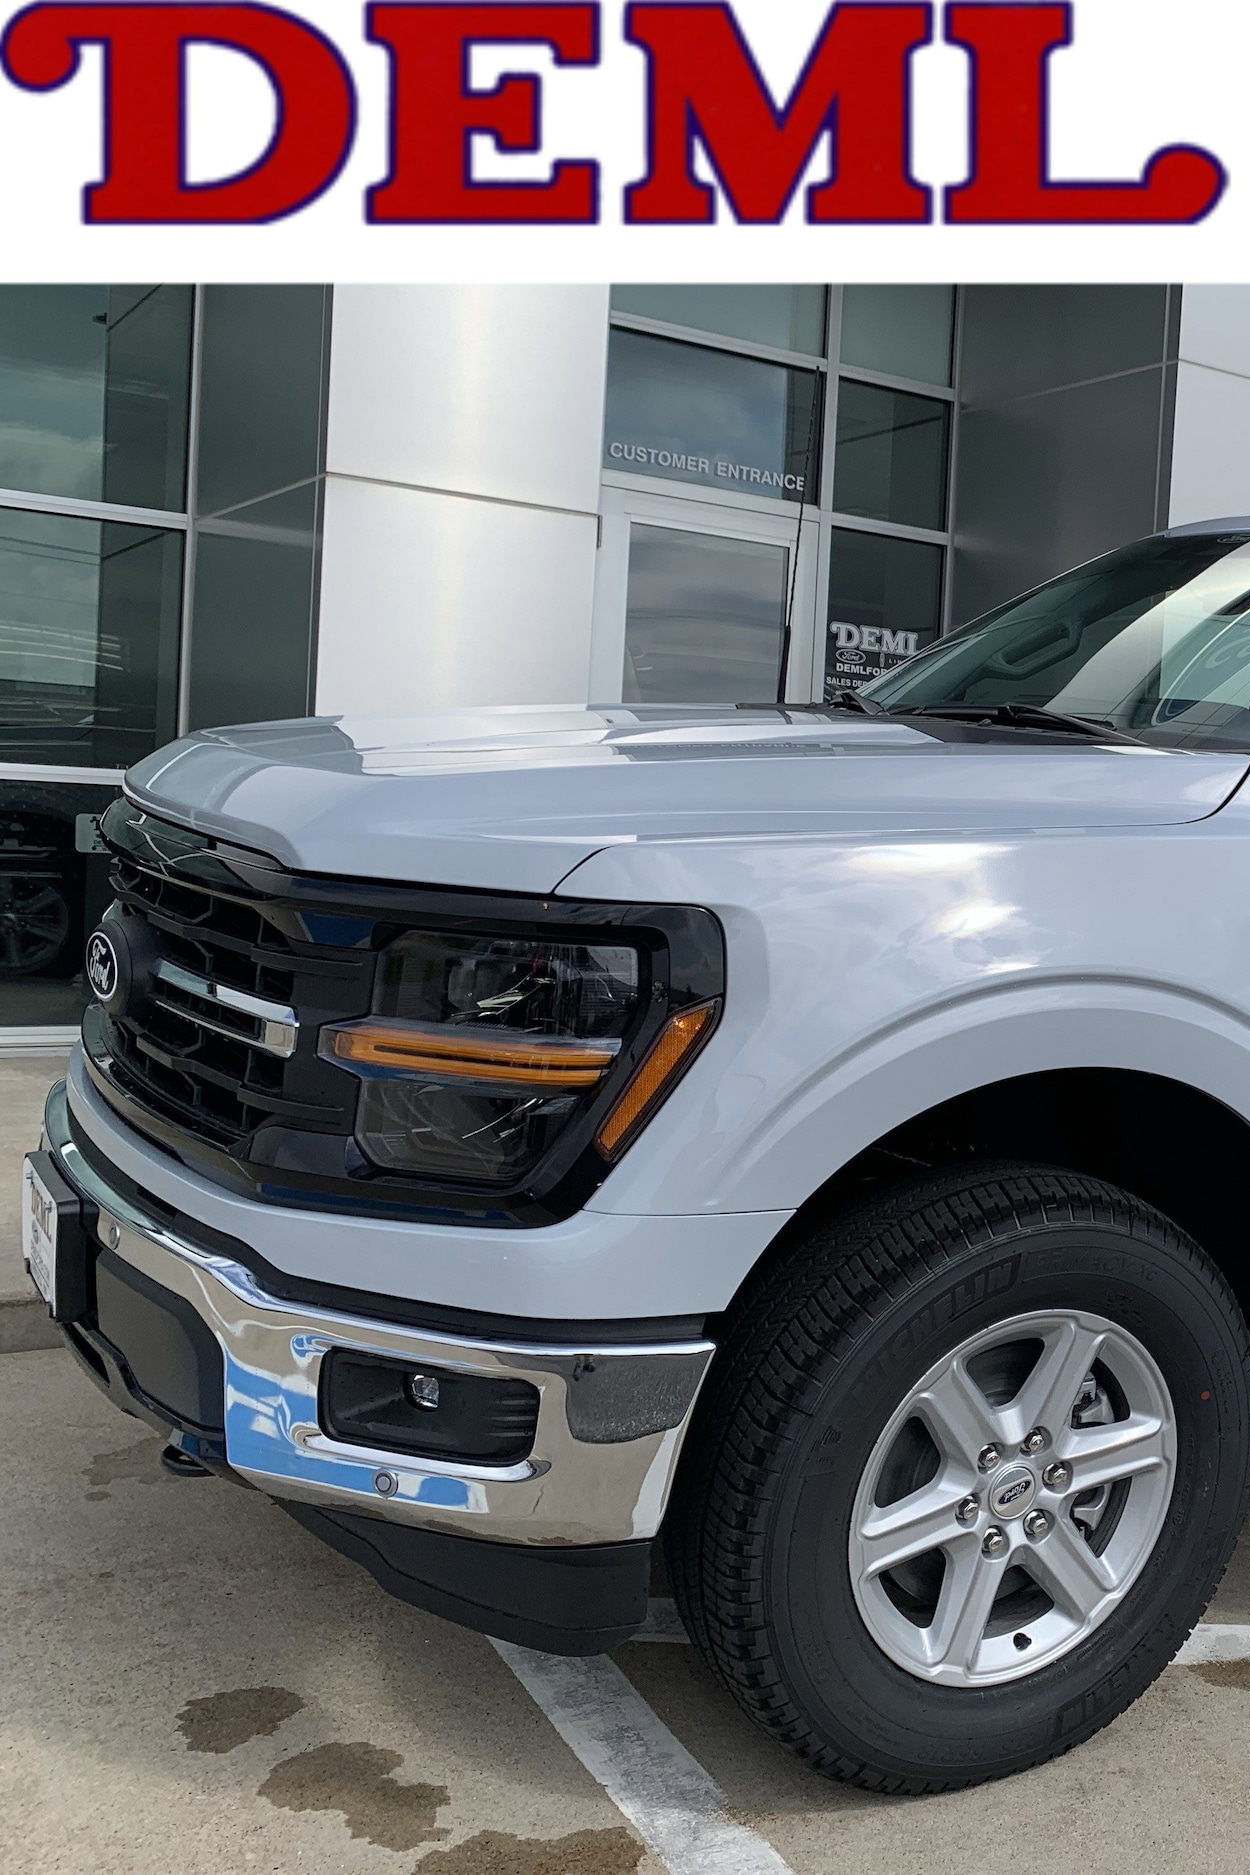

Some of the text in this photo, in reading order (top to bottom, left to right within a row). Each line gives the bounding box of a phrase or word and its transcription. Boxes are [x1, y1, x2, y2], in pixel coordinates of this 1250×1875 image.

[609, 442, 805, 491] CUSTOMER ENTRANCE
[830, 621, 919, 657] DEML
[826, 676, 851, 687] SALES
[90, 939, 111, 990] Ford
